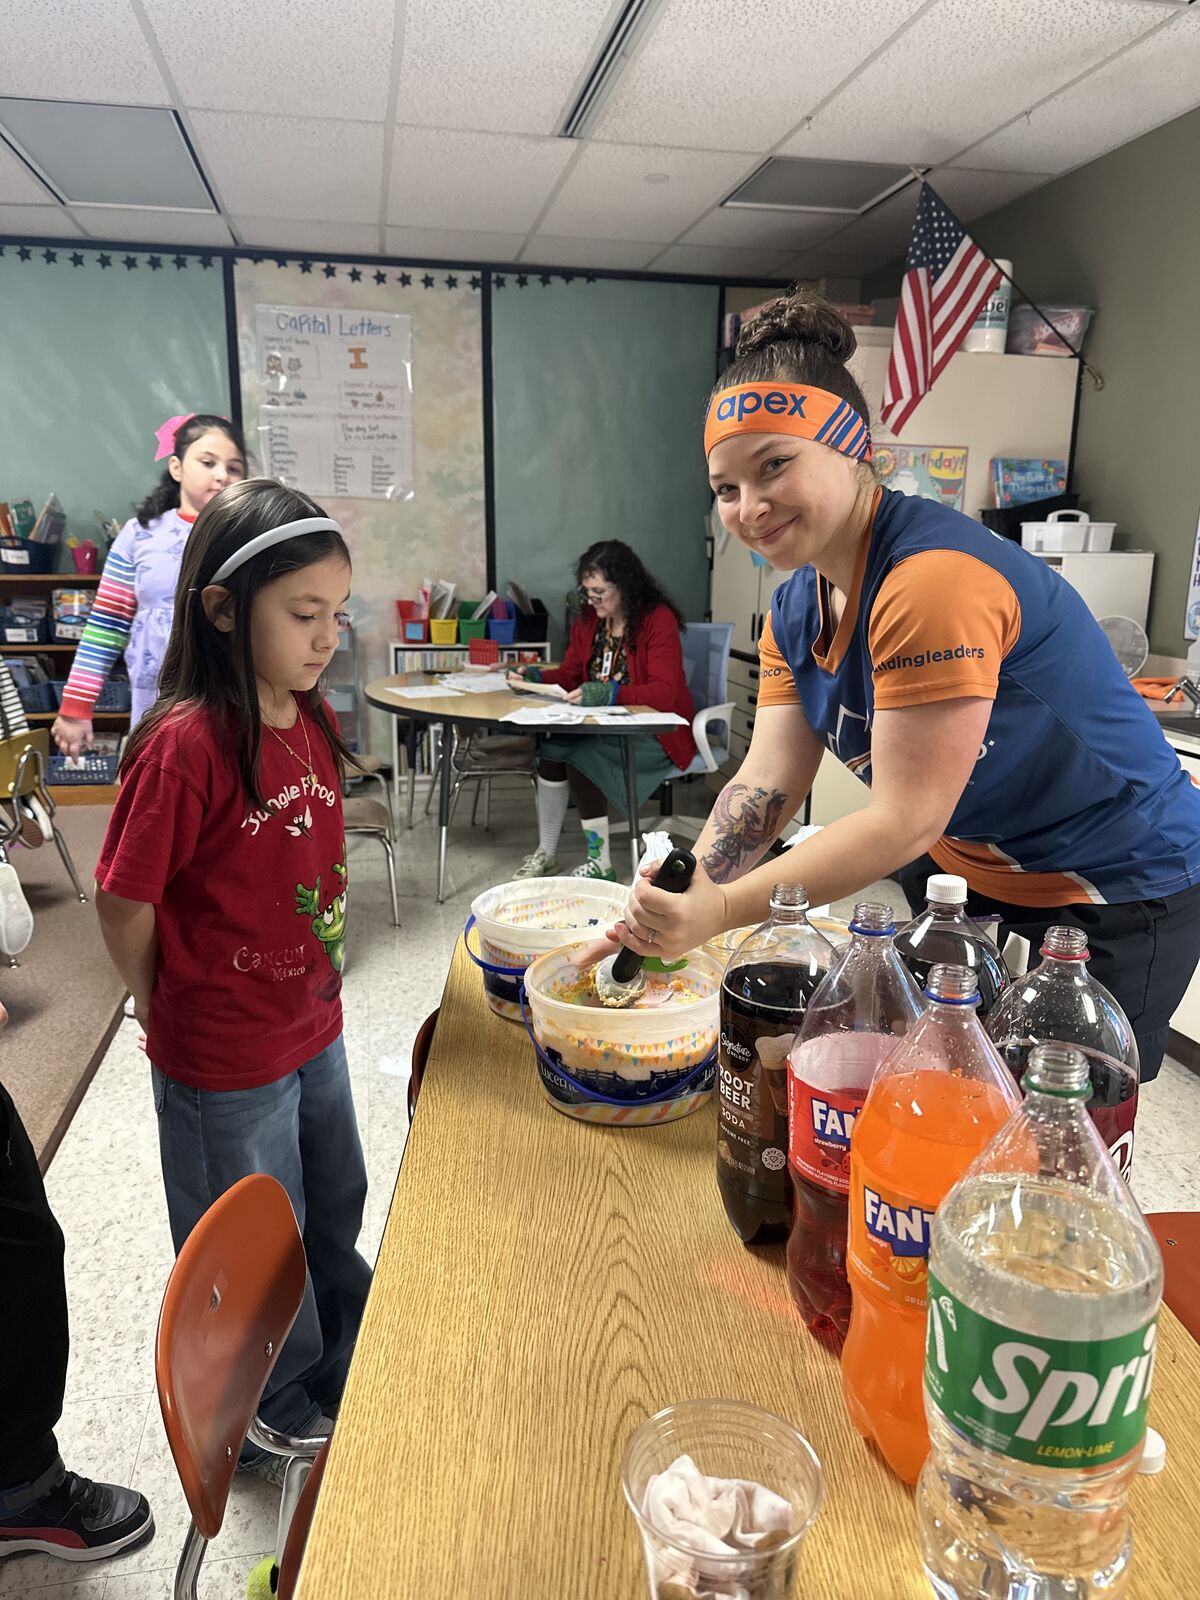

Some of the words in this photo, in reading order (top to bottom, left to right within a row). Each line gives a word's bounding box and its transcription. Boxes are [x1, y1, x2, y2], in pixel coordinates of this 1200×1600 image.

[339, 313, 392, 338] Letters
[717, 391, 808, 422] apex
[241, 785, 301, 836] Jungle
[301, 776, 336, 807] Frog
[721, 1032, 752, 1057] Signature
[731, 1051, 750, 1063] SELECT
[720, 1064, 754, 1095] ROOT
[720, 1080, 751, 1110] BEER
[722, 1107, 746, 1129] SODA
[812, 1099, 856, 1139] FAN
[814, 1137, 847, 1152] strawberry
[833, 1180, 850, 1189] FLAVO
[838, 1177, 850, 1185] SOD
[864, 1187, 935, 1243] FANT
[866, 1232, 888, 1249] orange
[971, 1322, 1157, 1442] Spri
[1036, 1440, 1116, 1459] LEMON-LIME
